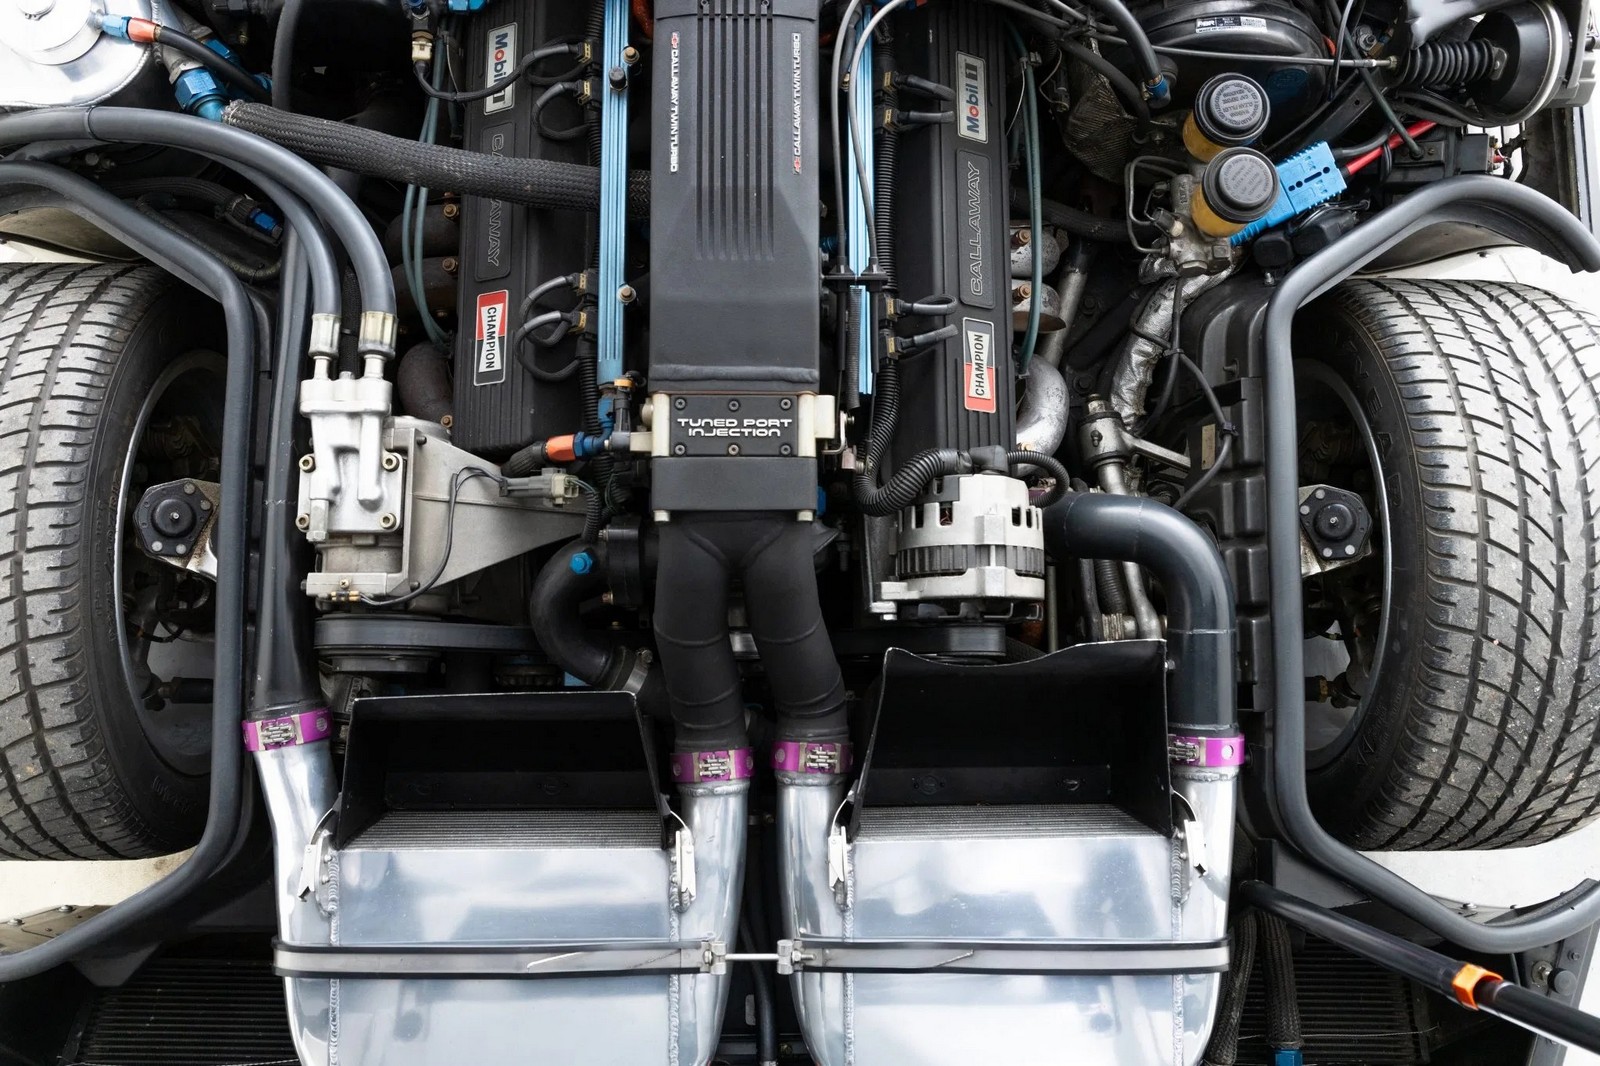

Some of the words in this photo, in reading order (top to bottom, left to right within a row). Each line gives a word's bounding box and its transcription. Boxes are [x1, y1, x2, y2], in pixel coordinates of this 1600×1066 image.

[494, 32, 508, 83] Mobil
[671, 49, 679, 104] CALLAWAY
[793, 100, 801, 156] CALLAWAY
[966, 83, 980, 134] Mobil
[968, 161, 983, 296] CALLAWAY
[485, 306, 497, 370] CHAMPION
[974, 334, 985, 396] CHAMPION
[677, 418, 738, 427] TUNED
[743, 418, 793, 427] PORT
[688, 428, 781, 437] INJECTION
